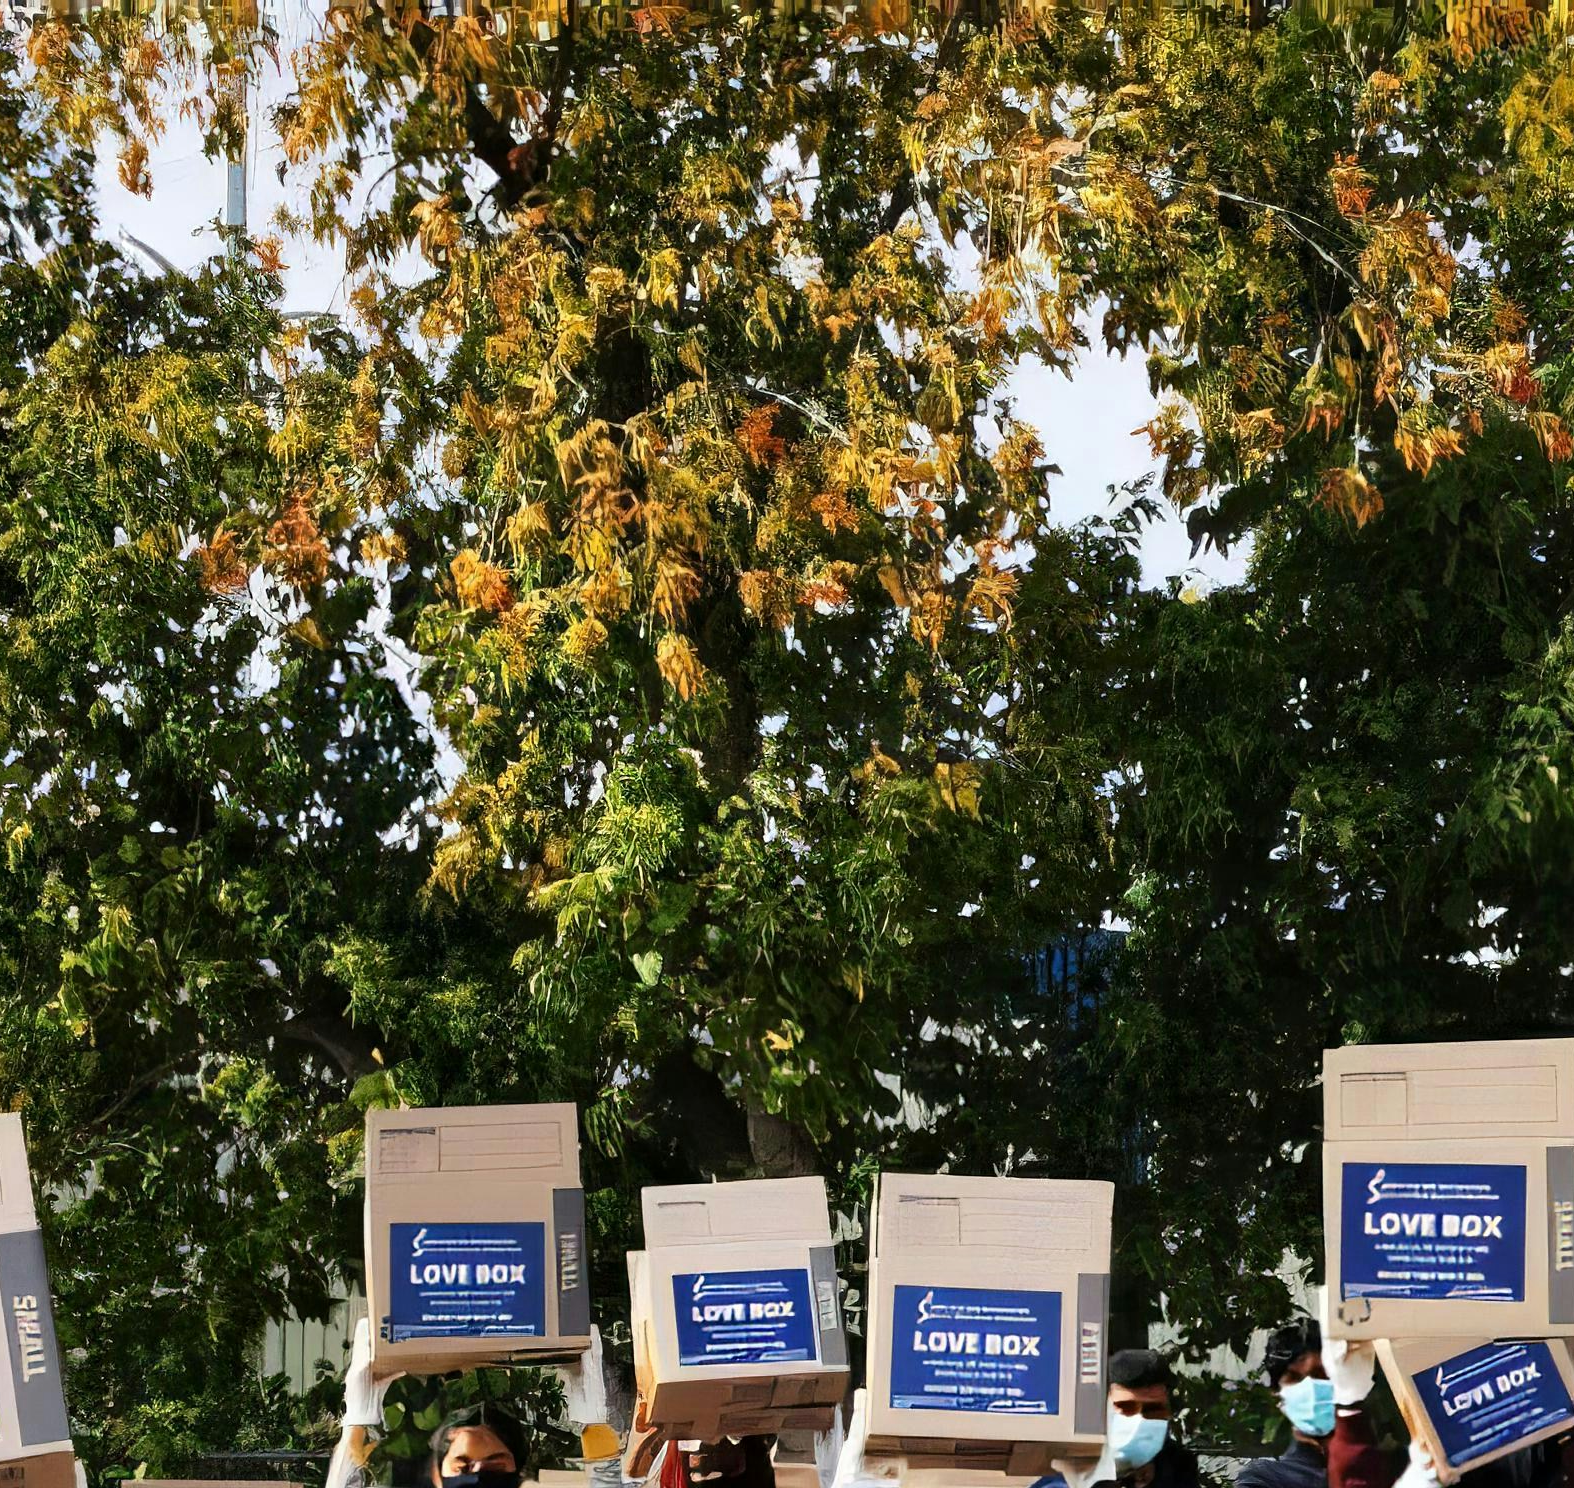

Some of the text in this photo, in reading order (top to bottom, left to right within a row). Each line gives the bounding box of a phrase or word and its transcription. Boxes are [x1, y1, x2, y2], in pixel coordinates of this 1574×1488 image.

[1364, 1212, 1503, 1239] LOVE BOX
[410, 1263, 526, 1285] LOVE BOX
[750, 1300, 795, 1321] BOX
[13, 1294, 47, 1383] SMALL
[913, 1330, 1041, 1357] LOVE BOX
[1441, 1383, 1494, 1417] LOVE
[1495, 1361, 1542, 1394] BOX
